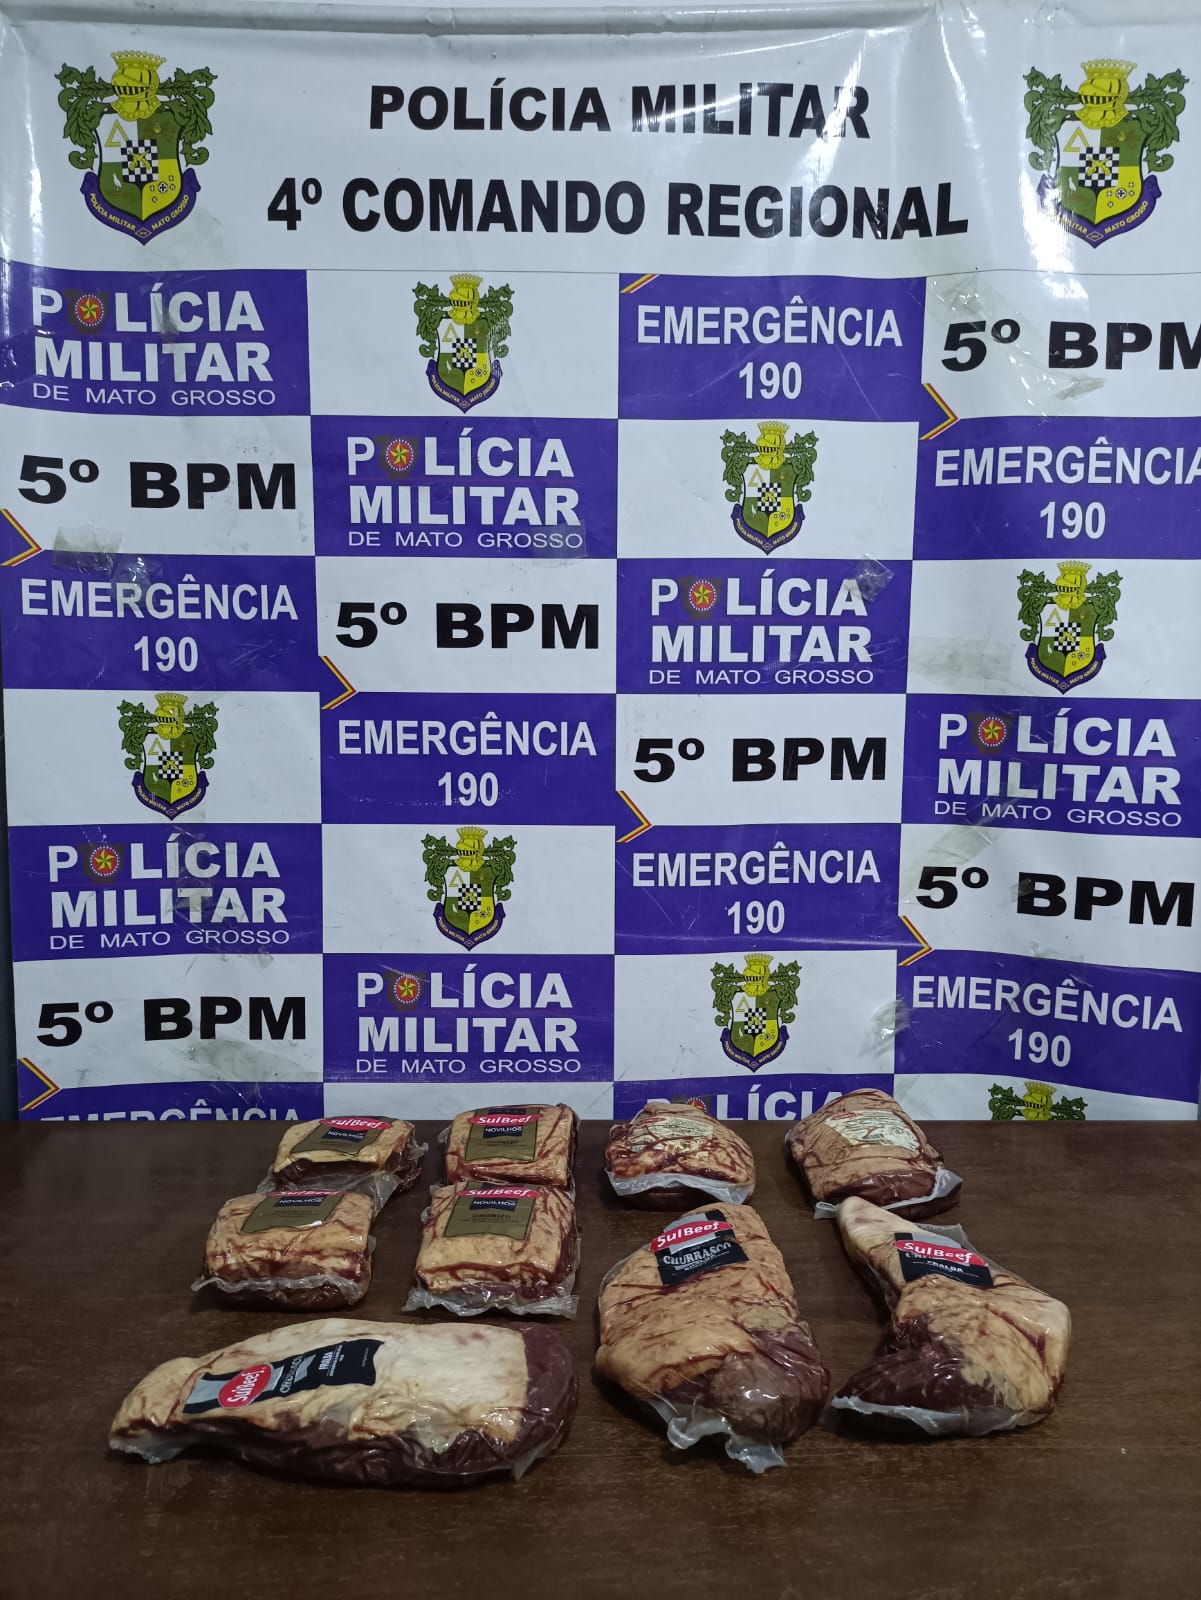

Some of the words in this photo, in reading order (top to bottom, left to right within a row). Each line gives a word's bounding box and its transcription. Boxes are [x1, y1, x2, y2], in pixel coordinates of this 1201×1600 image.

[371, 78, 609, 131] POLÍCIA
[633, 83, 869, 138] MILITAR
[90, 193, 108, 218] POLÍCIA
[108, 214, 136, 231] MILITAR
[151, 216, 171, 231] MATO
[170, 194, 190, 218] GROSSO
[268, 178, 322, 230] 4º
[343, 178, 644, 234] COMANDO
[668, 183, 968, 239] REGIONAL
[1104, 219, 1126, 234] MATO
[1126, 200, 1149, 223] GROSSO
[638, 296, 902, 346] EMERGÊNCIA
[35, 337, 272, 382] MILITAR
[1049, 322, 1201, 369] BPM
[34, 383, 68, 400] DE
[87, 388, 155, 404] MATO
[172, 390, 275, 405] GROSSO
[740, 362, 801, 399] 190
[936, 437, 1201, 486] EMERGÊNCIA
[130, 462, 295, 509] BPM
[350, 486, 580, 525] MILITAR
[1041, 502, 1105, 538] 190
[349, 532, 380, 545] DE
[396, 532, 462, 546] MATO
[478, 533, 582, 548] GROSSO
[22, 575, 297, 619] EMERGÊNCIA
[437, 603, 598, 649] BPM
[652, 626, 872, 662] MILITAR
[135, 637, 197, 671] 190
[650, 670, 680, 684] DE
[696, 670, 760, 684] MATO
[775, 670, 873, 684] GROSSO
[339, 712, 596, 755] EMERGÊNCIA
[733, 738, 886, 781] BPM
[439, 773, 498, 806] 190
[936, 758, 1181, 805] MILITAR
[934, 800, 954, 816] DE
[983, 804, 1051, 820] MATO
[1068, 809, 1181, 826] GROSSO
[634, 842, 880, 886] EMERGÊNCIA
[52, 888, 287, 927] MILITAR
[728, 901, 784, 933] 190
[1017, 872, 1194, 927] BPM
[51, 935, 83, 949] DE
[101, 932, 170, 947] MATO
[186, 931, 289, 944] GROSSO
[144, 997, 305, 1041] BPM
[913, 976, 1182, 1033] EMERGÊNCIA
[359, 1017, 579, 1052] MILITAR
[1009, 1029, 1070, 1066] 190
[357, 1060, 386, 1072] DE
[402, 1060, 465, 1073] MATO
[480, 1059, 580, 1072] GROSSO
[477, 1115, 532, 1124] SulBeef
[465, 1189, 531, 1197] SulBeef
[657, 1221, 720, 1248] SulBeef
[903, 1242, 973, 1264] SulBeef
[663, 1241, 732, 1266] CHURRASCO
